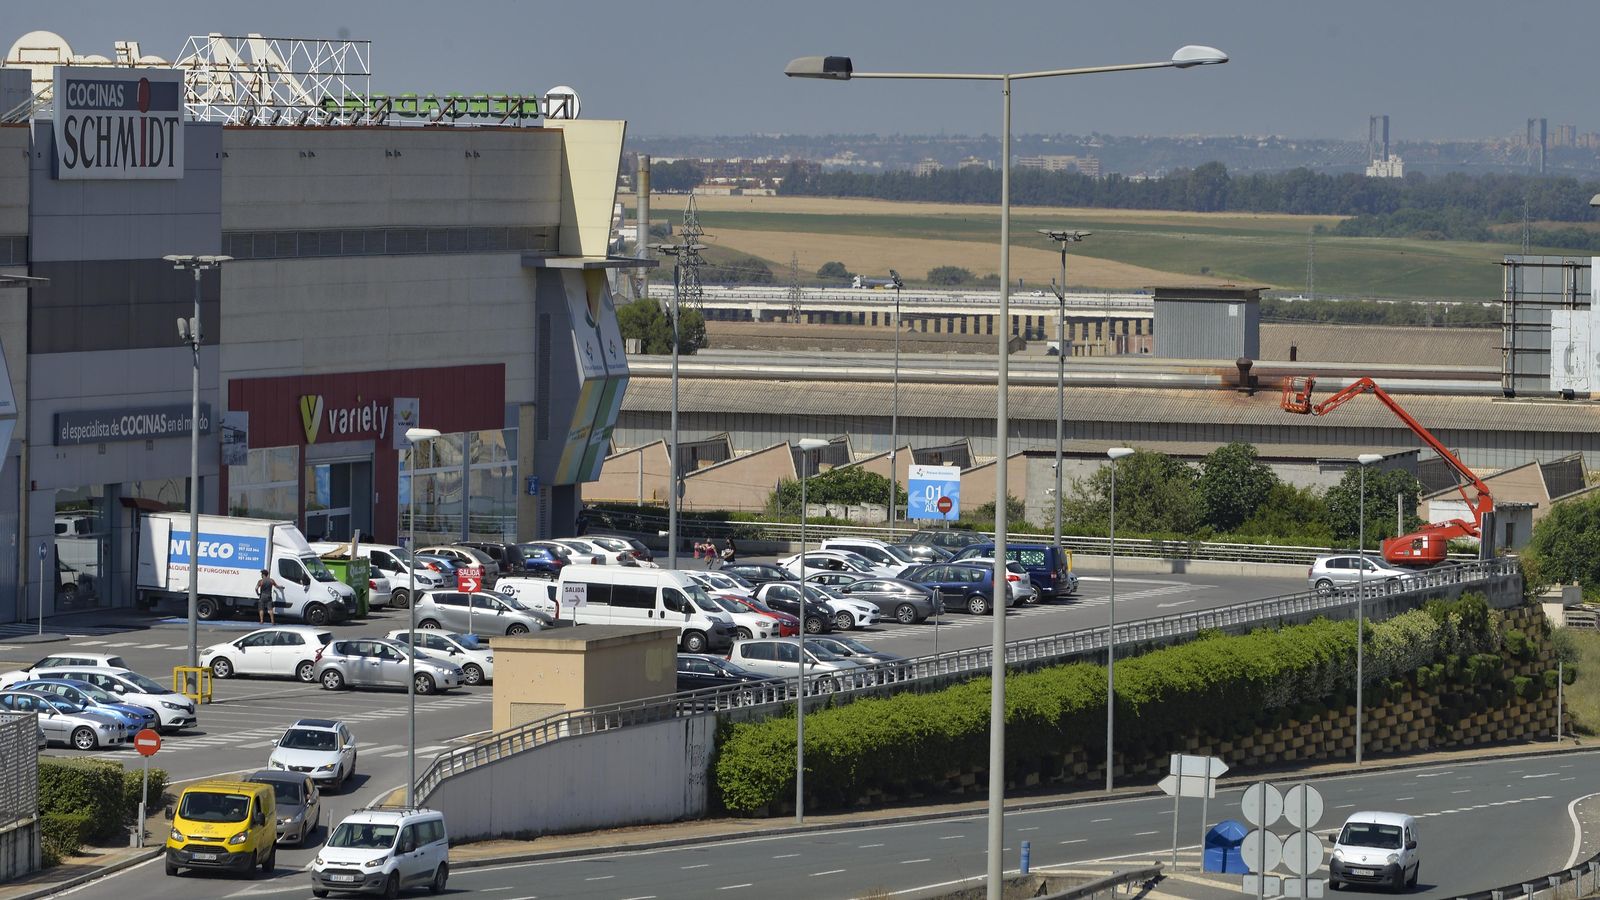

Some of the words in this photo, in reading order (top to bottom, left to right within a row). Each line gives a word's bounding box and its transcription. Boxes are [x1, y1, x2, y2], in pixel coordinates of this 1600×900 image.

[67, 82, 125, 107] COCINAS
[63, 115, 180, 172] SCHMIDT
[62, 422, 69, 439] el
[69, 419, 109, 444] especialista
[110, 418, 119, 436] de
[120, 414, 167, 436] COCINAS
[167, 419, 176, 432] en
[177, 413, 184, 431] el
[184, 412, 209, 431] mdo
[328, 395, 388, 439] variety
[925, 484, 941, 500] 01
[458, 567, 481, 576] SALIDA
